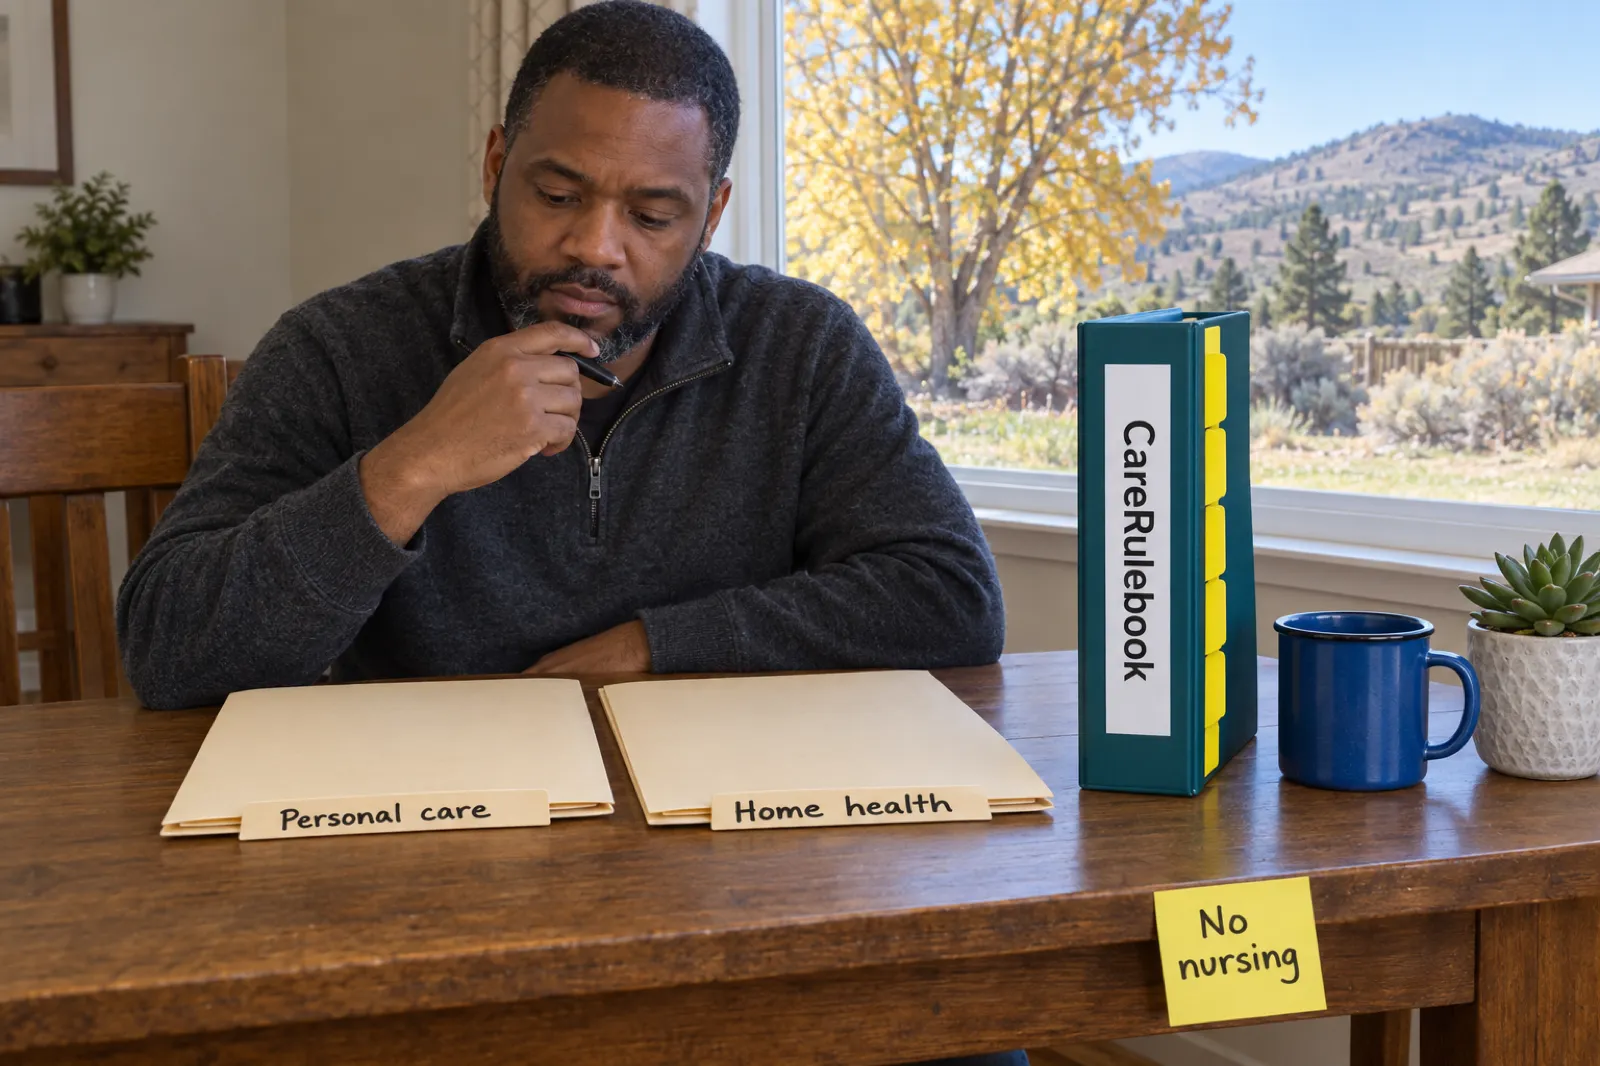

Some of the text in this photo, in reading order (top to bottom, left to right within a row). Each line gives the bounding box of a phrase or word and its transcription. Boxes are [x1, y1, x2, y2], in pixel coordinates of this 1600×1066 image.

[1123, 420, 1156, 682] CareRulebook
[279, 802, 492, 831] Personal care
[735, 792, 953, 823] Home health
[1199, 905, 1248, 939] No
[1178, 943, 1300, 985] nursing
